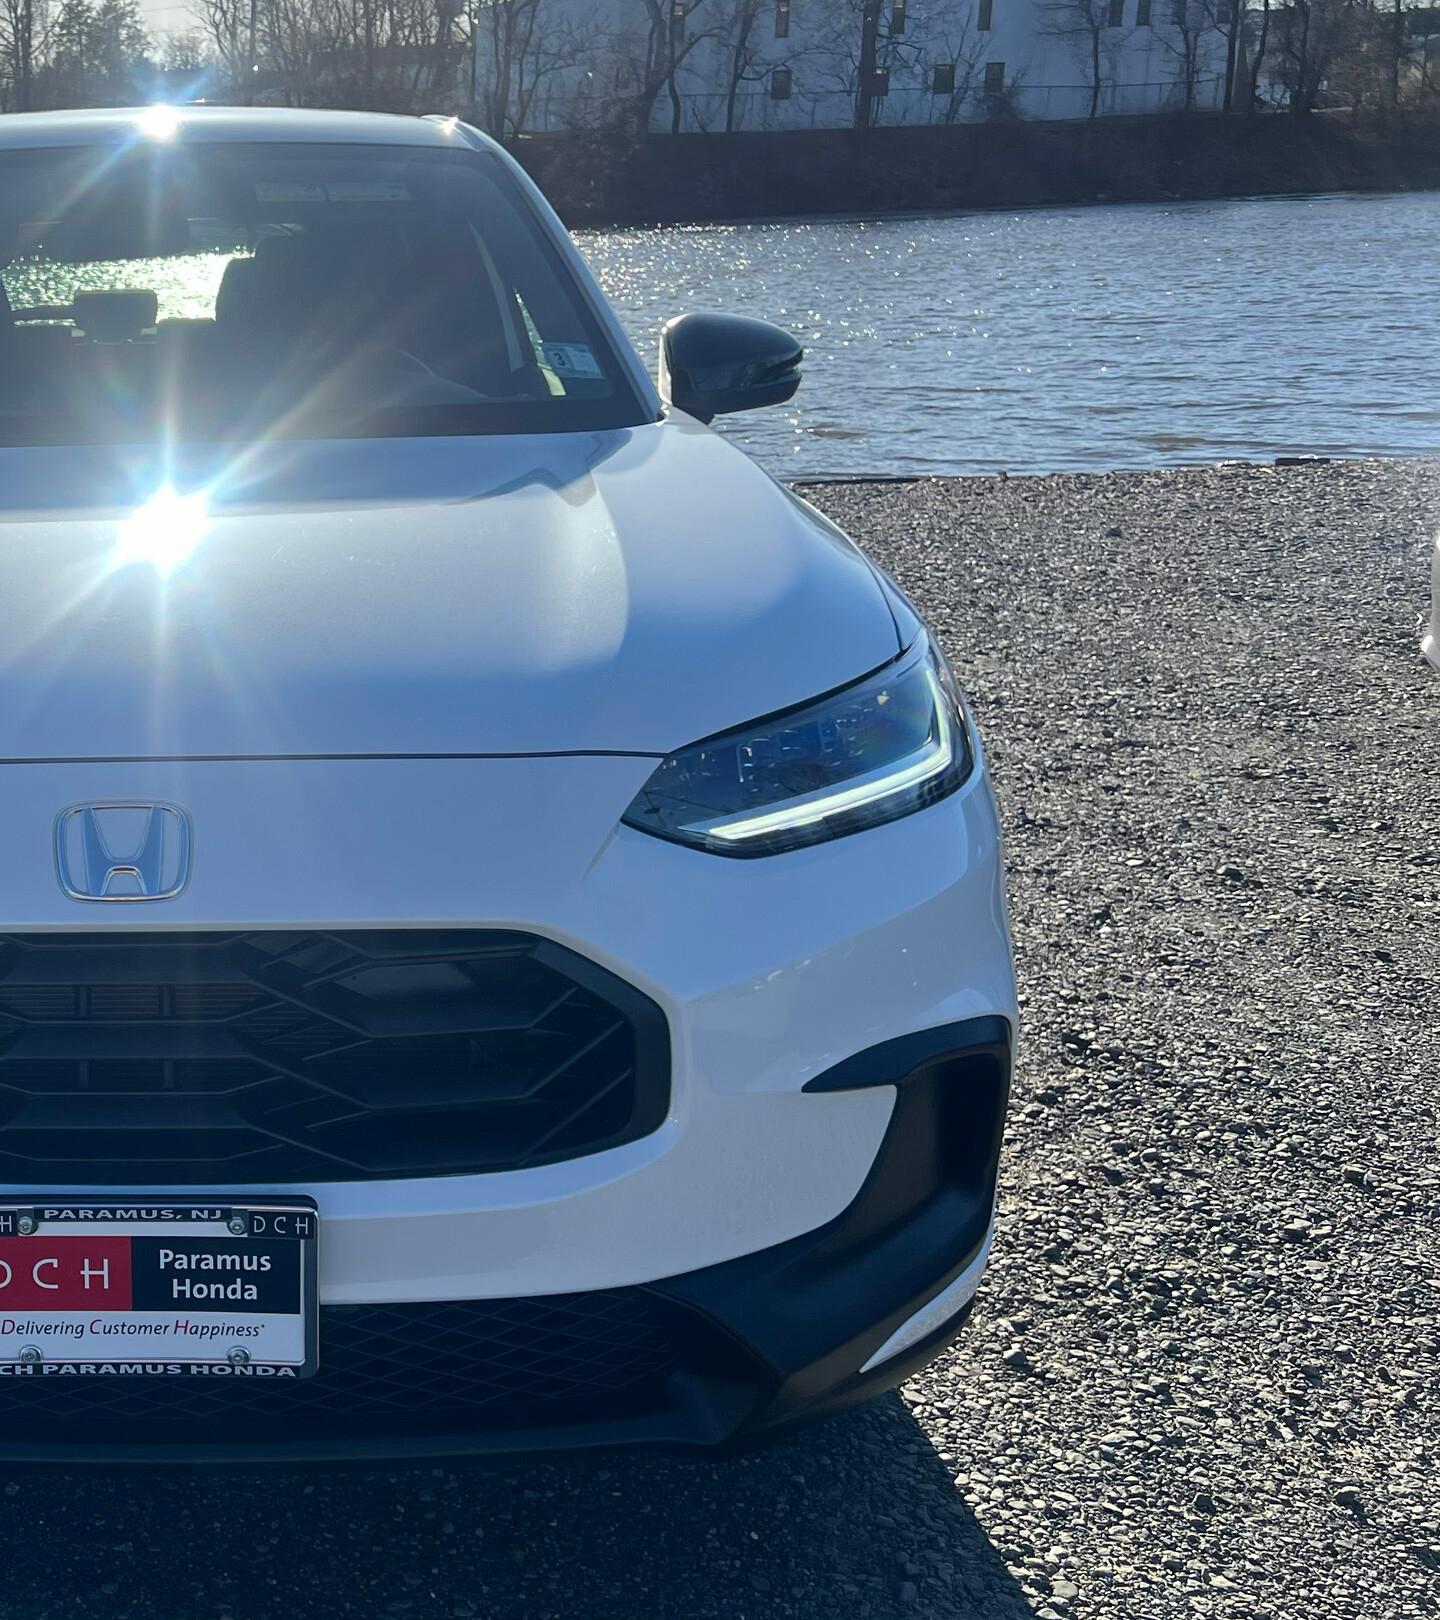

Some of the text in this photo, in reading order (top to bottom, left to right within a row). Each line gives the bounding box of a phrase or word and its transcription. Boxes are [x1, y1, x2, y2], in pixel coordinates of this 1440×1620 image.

[43, 1209, 222, 1220] PARAMUS, NJ
[159, 1249, 272, 1271] Paramus
[172, 1278, 258, 1300] Honda
[0, 1319, 85, 1339] Delivering
[89, 1319, 170, 1335] Customer
[42, 1364, 182, 1375] PARAMUS
[190, 1364, 296, 1377] HONDA
